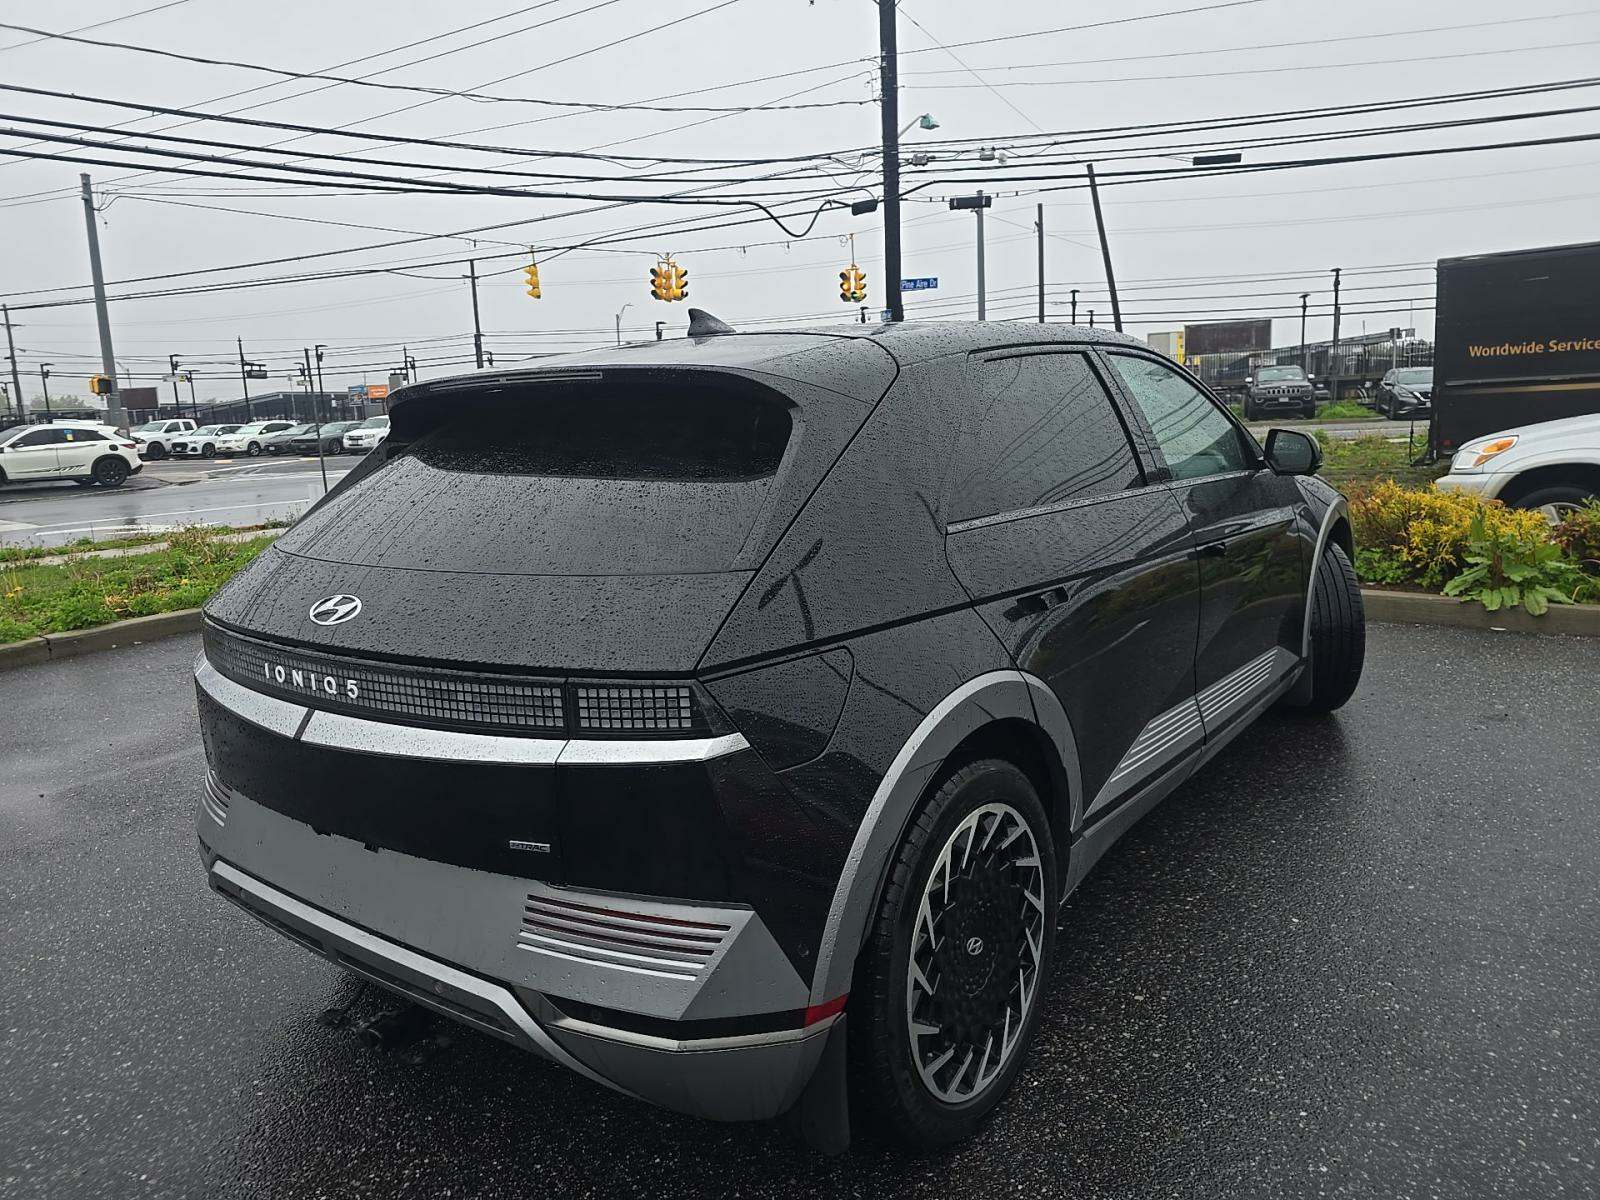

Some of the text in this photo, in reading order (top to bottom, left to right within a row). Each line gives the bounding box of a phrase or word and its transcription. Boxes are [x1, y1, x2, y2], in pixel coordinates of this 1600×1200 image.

[901, 278, 937, 289] Pine Aire Dr
[1469, 341, 1544, 357] Worldwide
[264, 662, 359, 699] IONIQ 5
